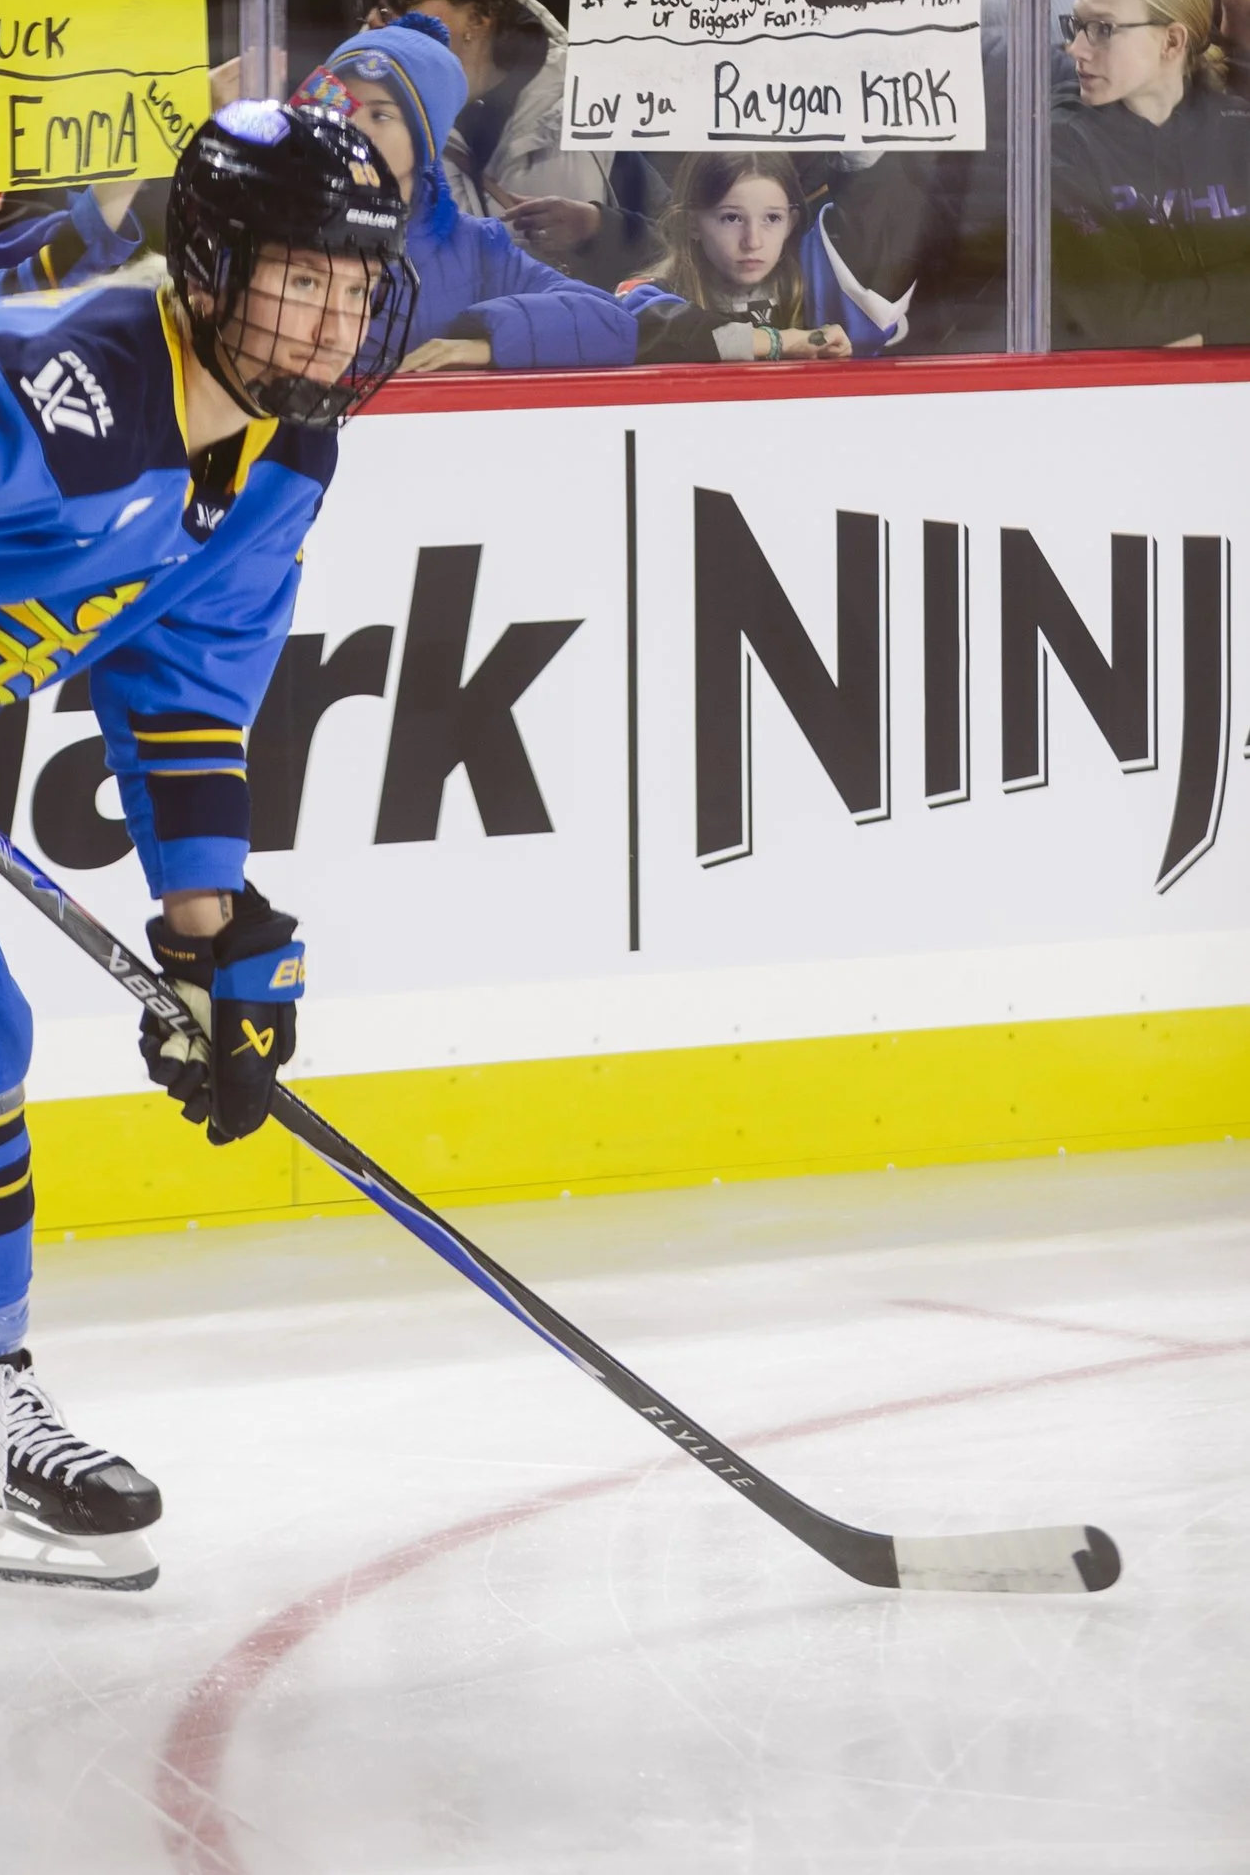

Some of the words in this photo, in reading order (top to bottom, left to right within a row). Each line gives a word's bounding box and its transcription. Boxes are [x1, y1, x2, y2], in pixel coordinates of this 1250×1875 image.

[689, 8, 749, 39] Biggest
[713, 61, 842, 136] Raygan
[860, 68, 957, 128] KIRK
[58, 350, 114, 437] PWHL
[694, 485, 1250, 895] NINJ
[640, 1406, 756, 1488] FLYLITE
